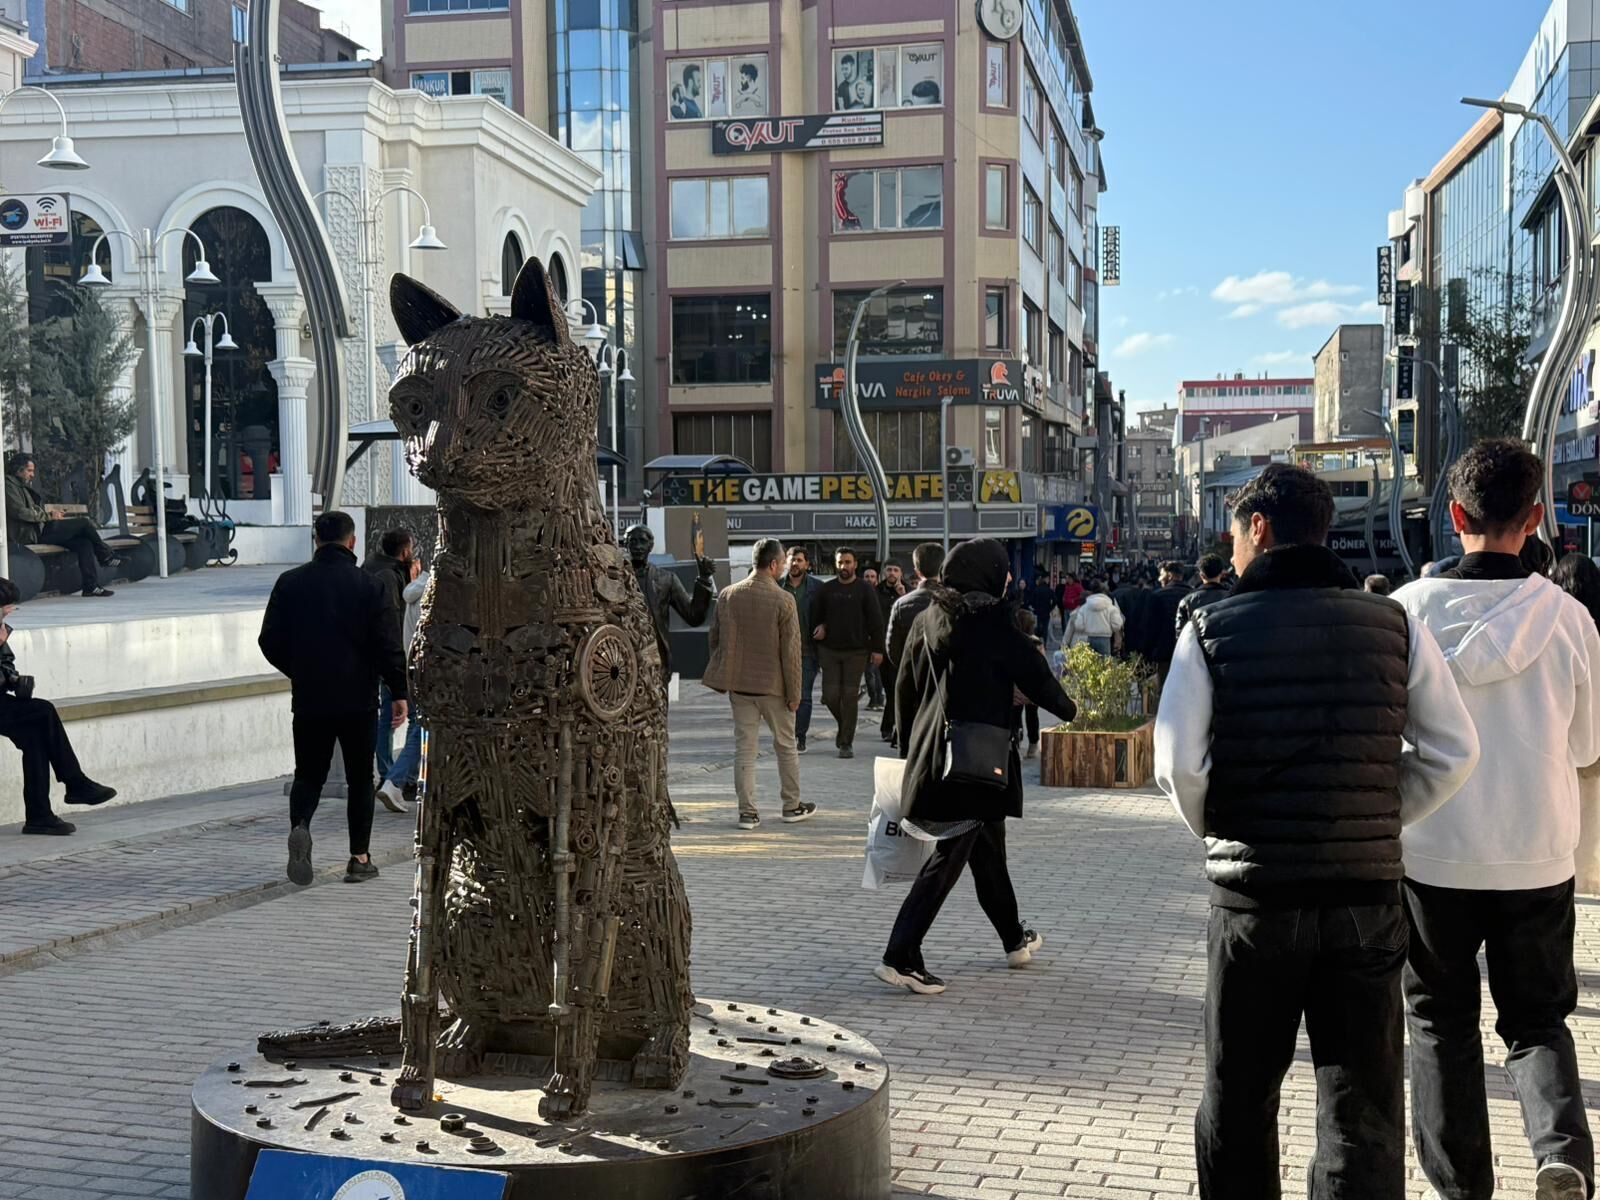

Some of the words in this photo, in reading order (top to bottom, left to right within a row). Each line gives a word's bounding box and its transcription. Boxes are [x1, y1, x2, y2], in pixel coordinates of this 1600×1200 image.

[903, 371, 925, 385] Cafe
[928, 370, 952, 383] Okey
[820, 382, 887, 400] TRVA
[895, 385, 932, 399] Nargile
[937, 384, 971, 397] Salonu
[982, 388, 1020, 401] TRUVA
[689, 478, 740, 502] THE
[845, 516, 877, 527] HAKA
[1331, 537, 1366, 550] DÖNER
